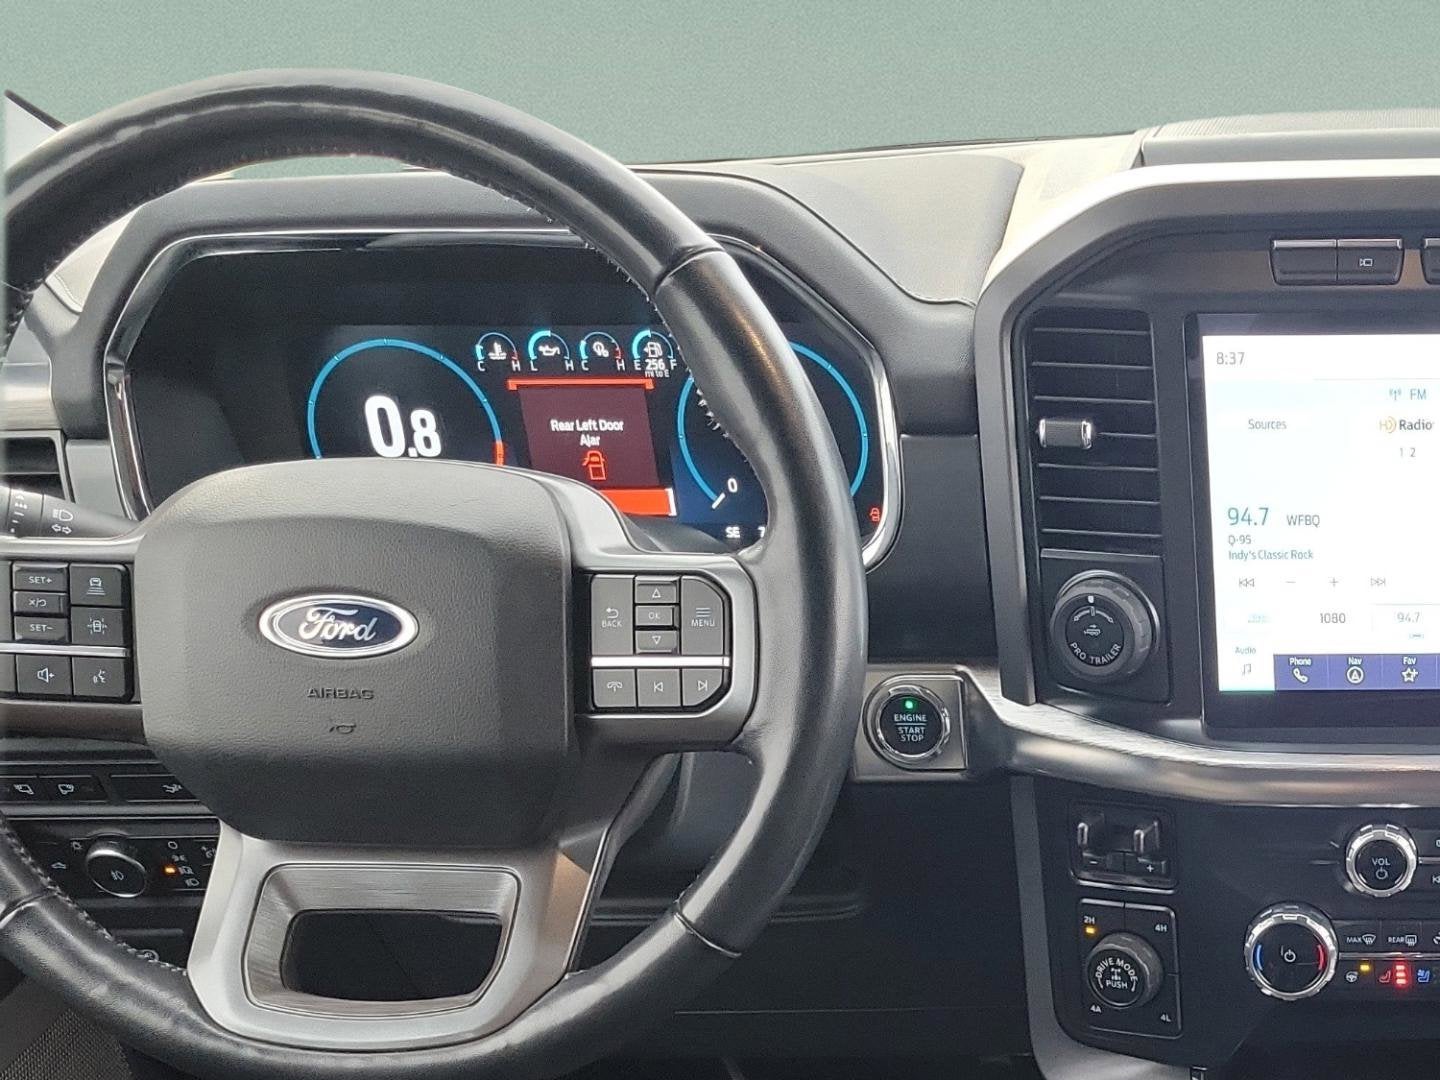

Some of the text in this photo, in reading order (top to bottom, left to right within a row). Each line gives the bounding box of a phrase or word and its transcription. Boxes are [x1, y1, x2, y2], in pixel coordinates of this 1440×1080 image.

[1216, 352, 1245, 365] 8:37
[477, 361, 485, 371] C
[512, 361, 521, 371] H
[530, 361, 538, 371] L
[565, 361, 574, 371] H
[580, 361, 589, 371] C
[616, 361, 625, 371] H
[634, 360, 641, 370] E
[645, 359, 665, 370] 256
[670, 359, 677, 370] F
[1410, 388, 1427, 400] FM
[365, 395, 442, 458] 0.8
[550, 419, 624, 432] Rear Left Door
[1248, 418, 1287, 430] Sources
[1399, 418, 1433, 431] Radio
[580, 434, 600, 447] Ajar
[1409, 446, 1416, 458] 2
[727, 477, 738, 493] 0
[1227, 507, 1321, 528] 94.7 WFBQ
[725, 526, 741, 539] SE
[1228, 549, 1314, 562] Indy's Classic Rock
[648, 611, 660, 620] OK
[1320, 612, 1346, 624] 1080
[1396, 612, 1420, 623] 94.7
[298, 606, 378, 641] Ford
[601, 620, 623, 628] BACK
[691, 618, 715, 627] MENU
[1070, 641, 1122, 665] PRO TRAILER
[1234, 645, 1257, 656] Audio
[1289, 656, 1312, 668] Phone
[1348, 656, 1363, 667] Nav
[1403, 656, 1416, 667] Fav
[307, 686, 375, 701] AIRBAG
[893, 714, 928, 722] ENGINE
[898, 726, 926, 735] START
[900, 734, 924, 742] STOP
[1371, 856, 1391, 866] VOL
[1084, 915, 1096, 925] 2H
[1155, 923, 1168, 933] 4H
[1346, 936, 1362, 944] MAX
[1387, 936, 1404, 944] REAR
[1095, 957, 1138, 981] DRIVE MODE
[1105, 979, 1128, 989] PUSH
[1090, 1004, 1102, 1014] 4A
[1160, 1013, 1172, 1023] 4L
